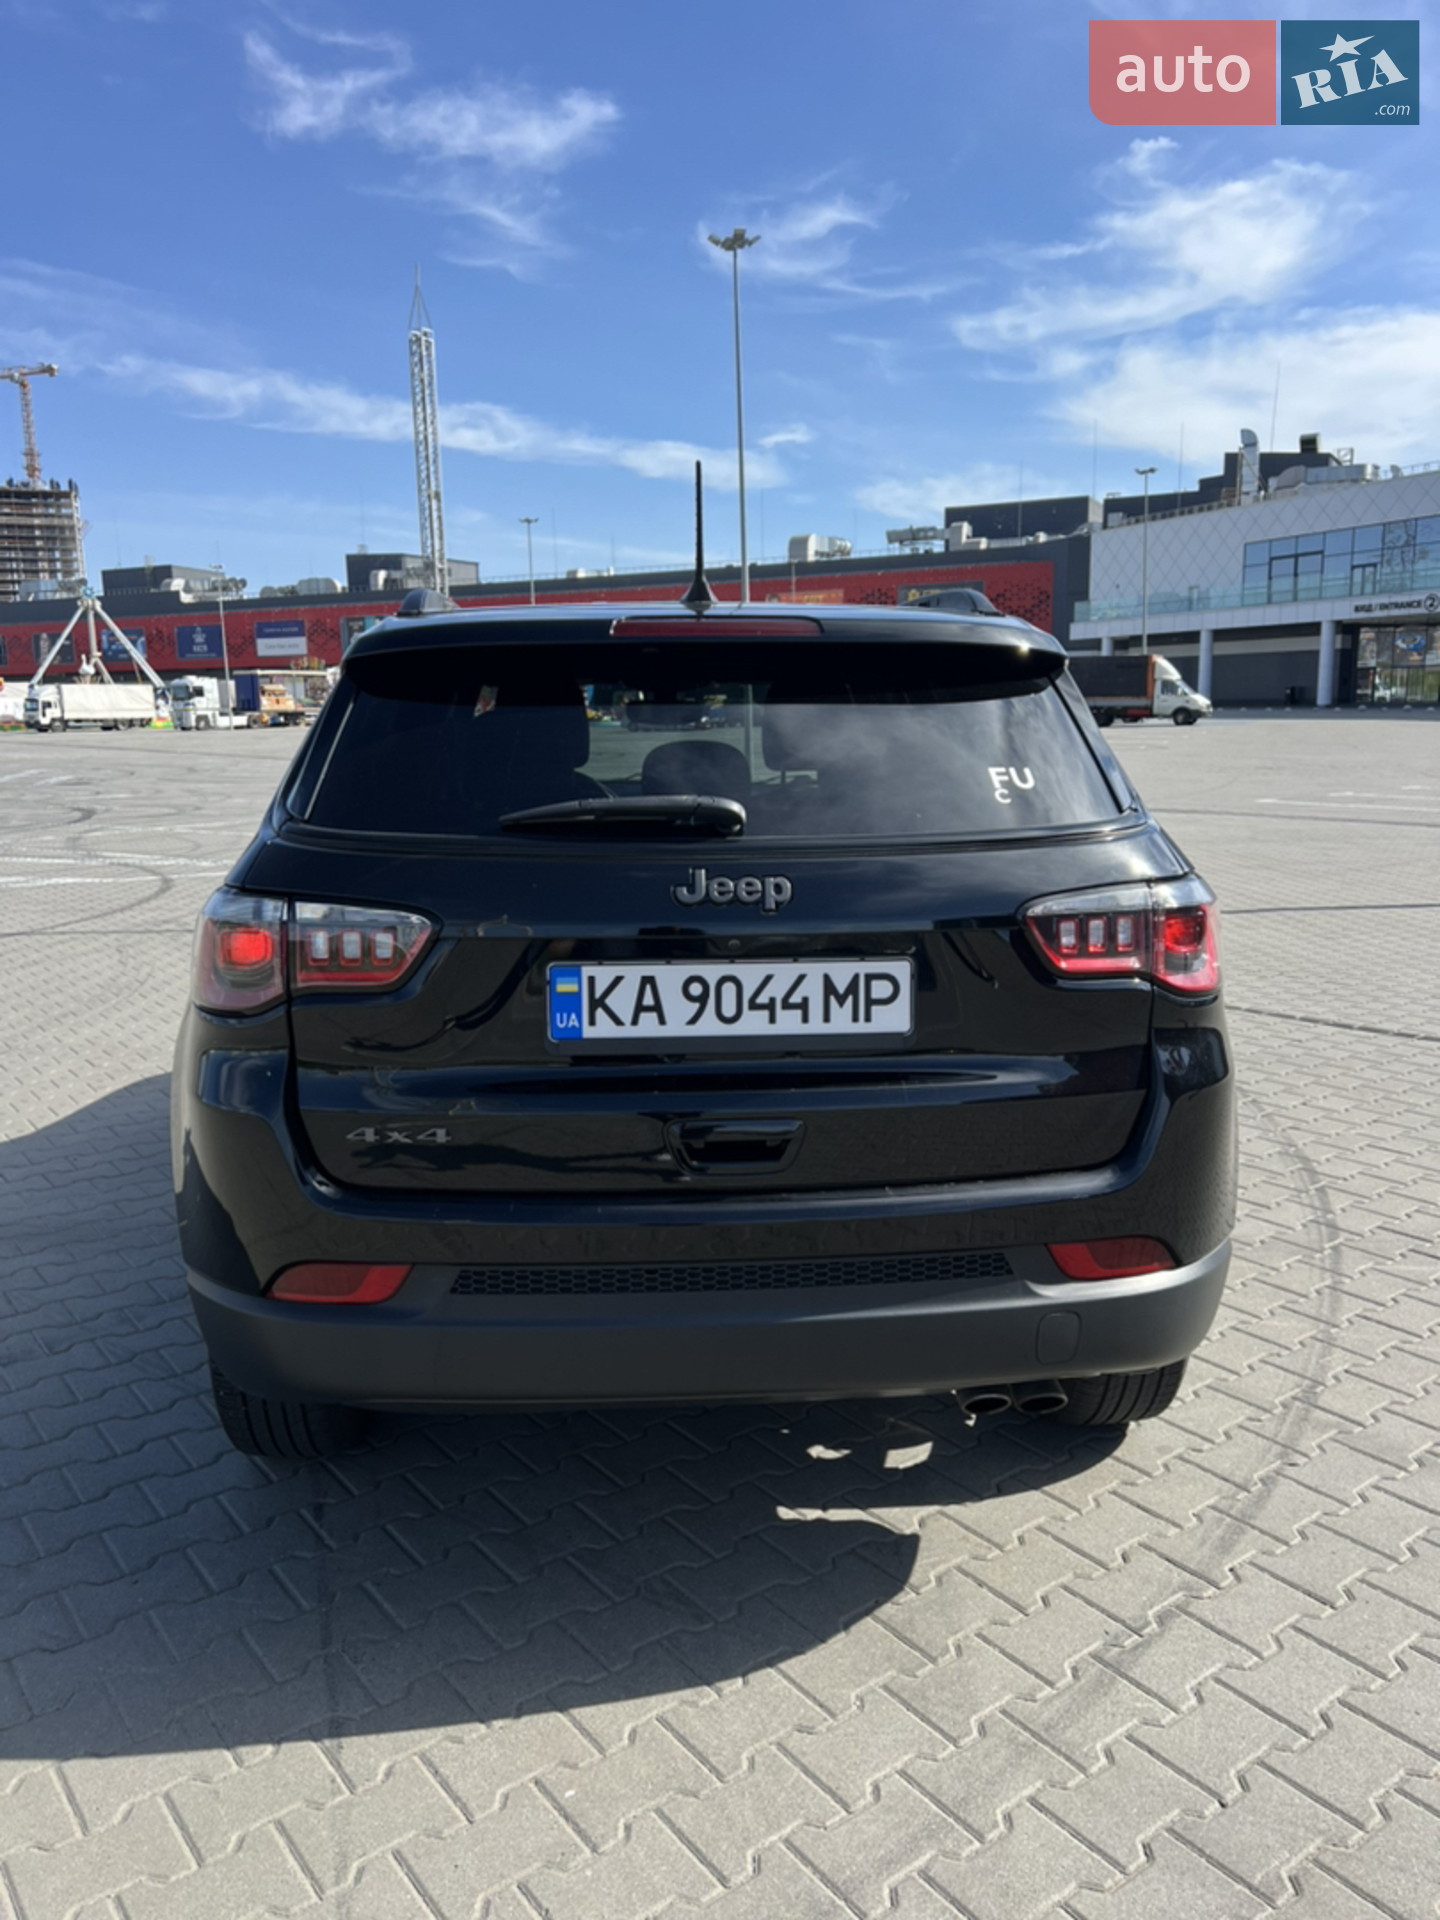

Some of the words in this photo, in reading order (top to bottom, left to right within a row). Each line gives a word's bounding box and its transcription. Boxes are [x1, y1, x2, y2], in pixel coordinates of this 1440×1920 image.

[672, 868, 793, 915] Jeep
[587, 974, 667, 1027] KA
[681, 973, 810, 1026] 9044
[822, 971, 902, 1024] MP
[555, 1011, 580, 1029] UA
[345, 1126, 452, 1143] 4x4
